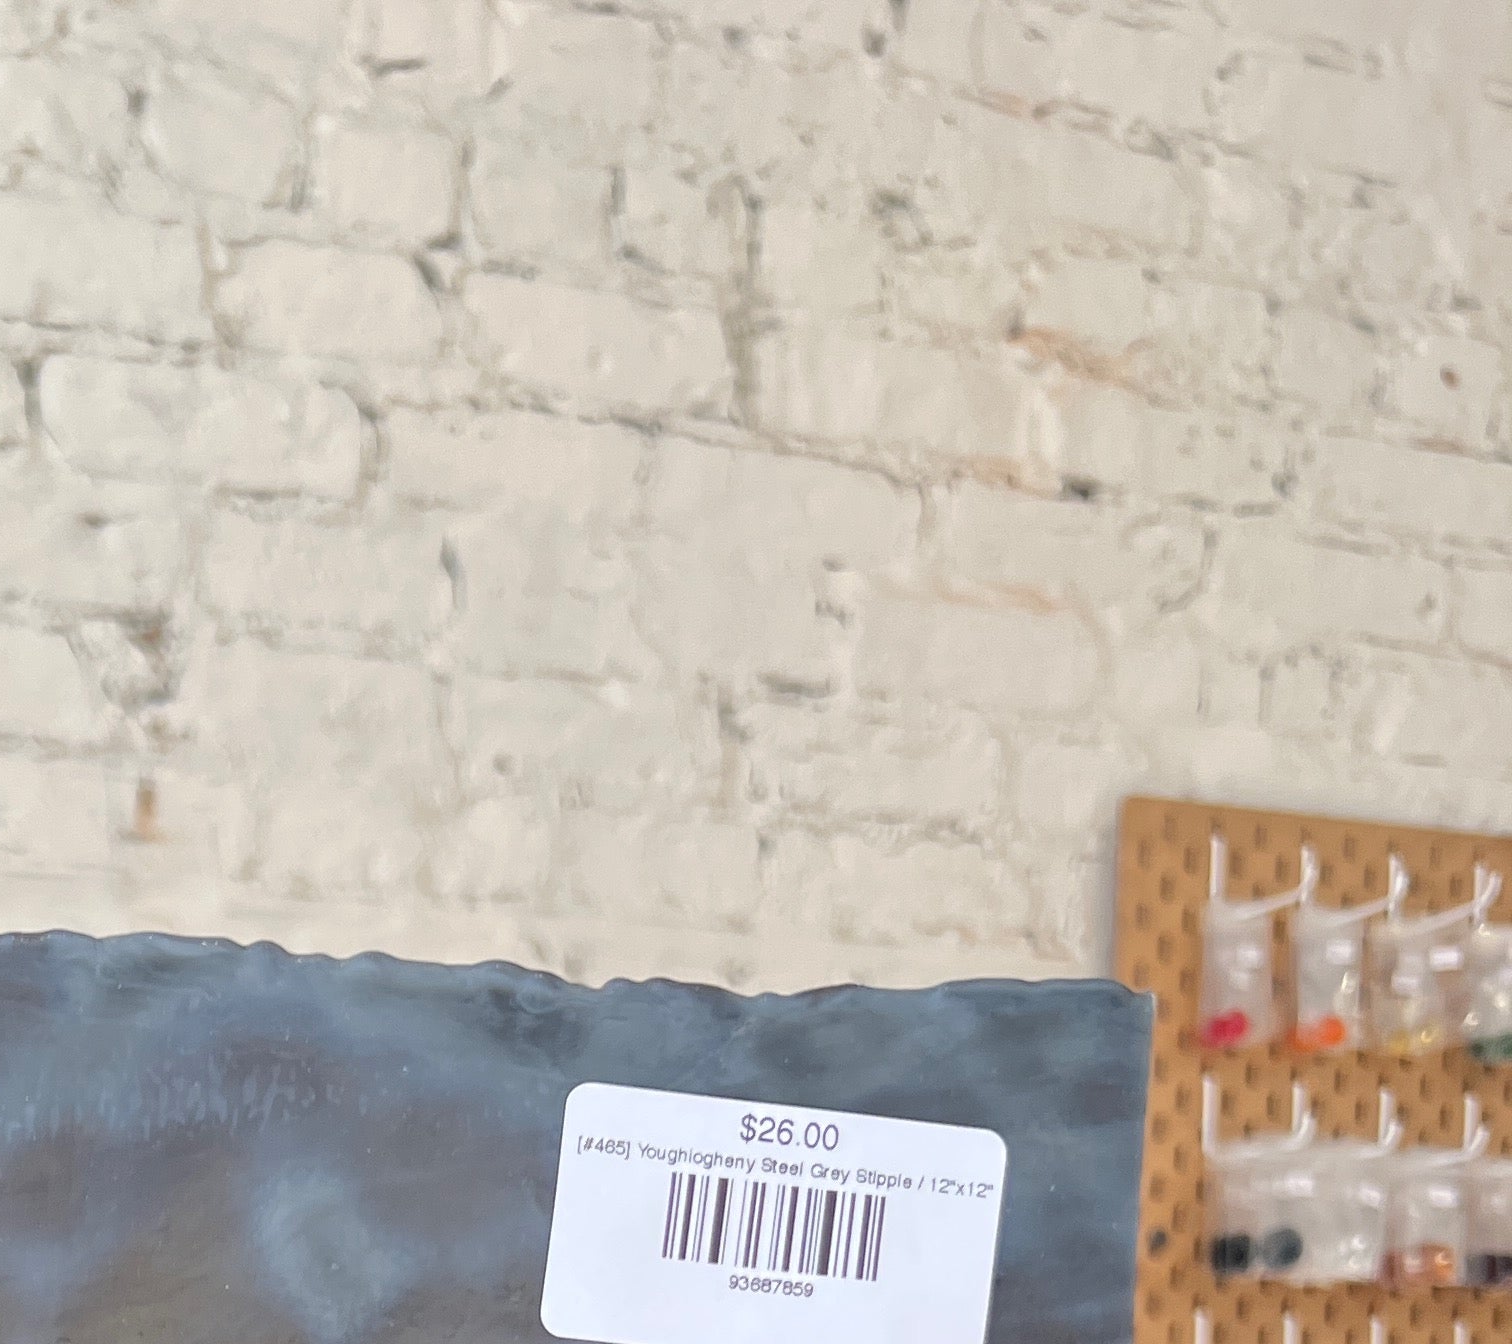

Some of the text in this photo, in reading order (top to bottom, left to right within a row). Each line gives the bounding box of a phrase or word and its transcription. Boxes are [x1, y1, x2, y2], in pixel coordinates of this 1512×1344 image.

[740, 1113, 840, 1151] $26.00
[577, 1135, 630, 1161] [#465]
[638, 1142, 756, 1174] Youghiogheny
[761, 1157, 804, 1177] Steel
[810, 1163, 850, 1185] Grey
[856, 1168, 912, 1190] Stipple
[931, 1177, 994, 1199] 12"x12"
[728, 1274, 814, 1298] 93687859
